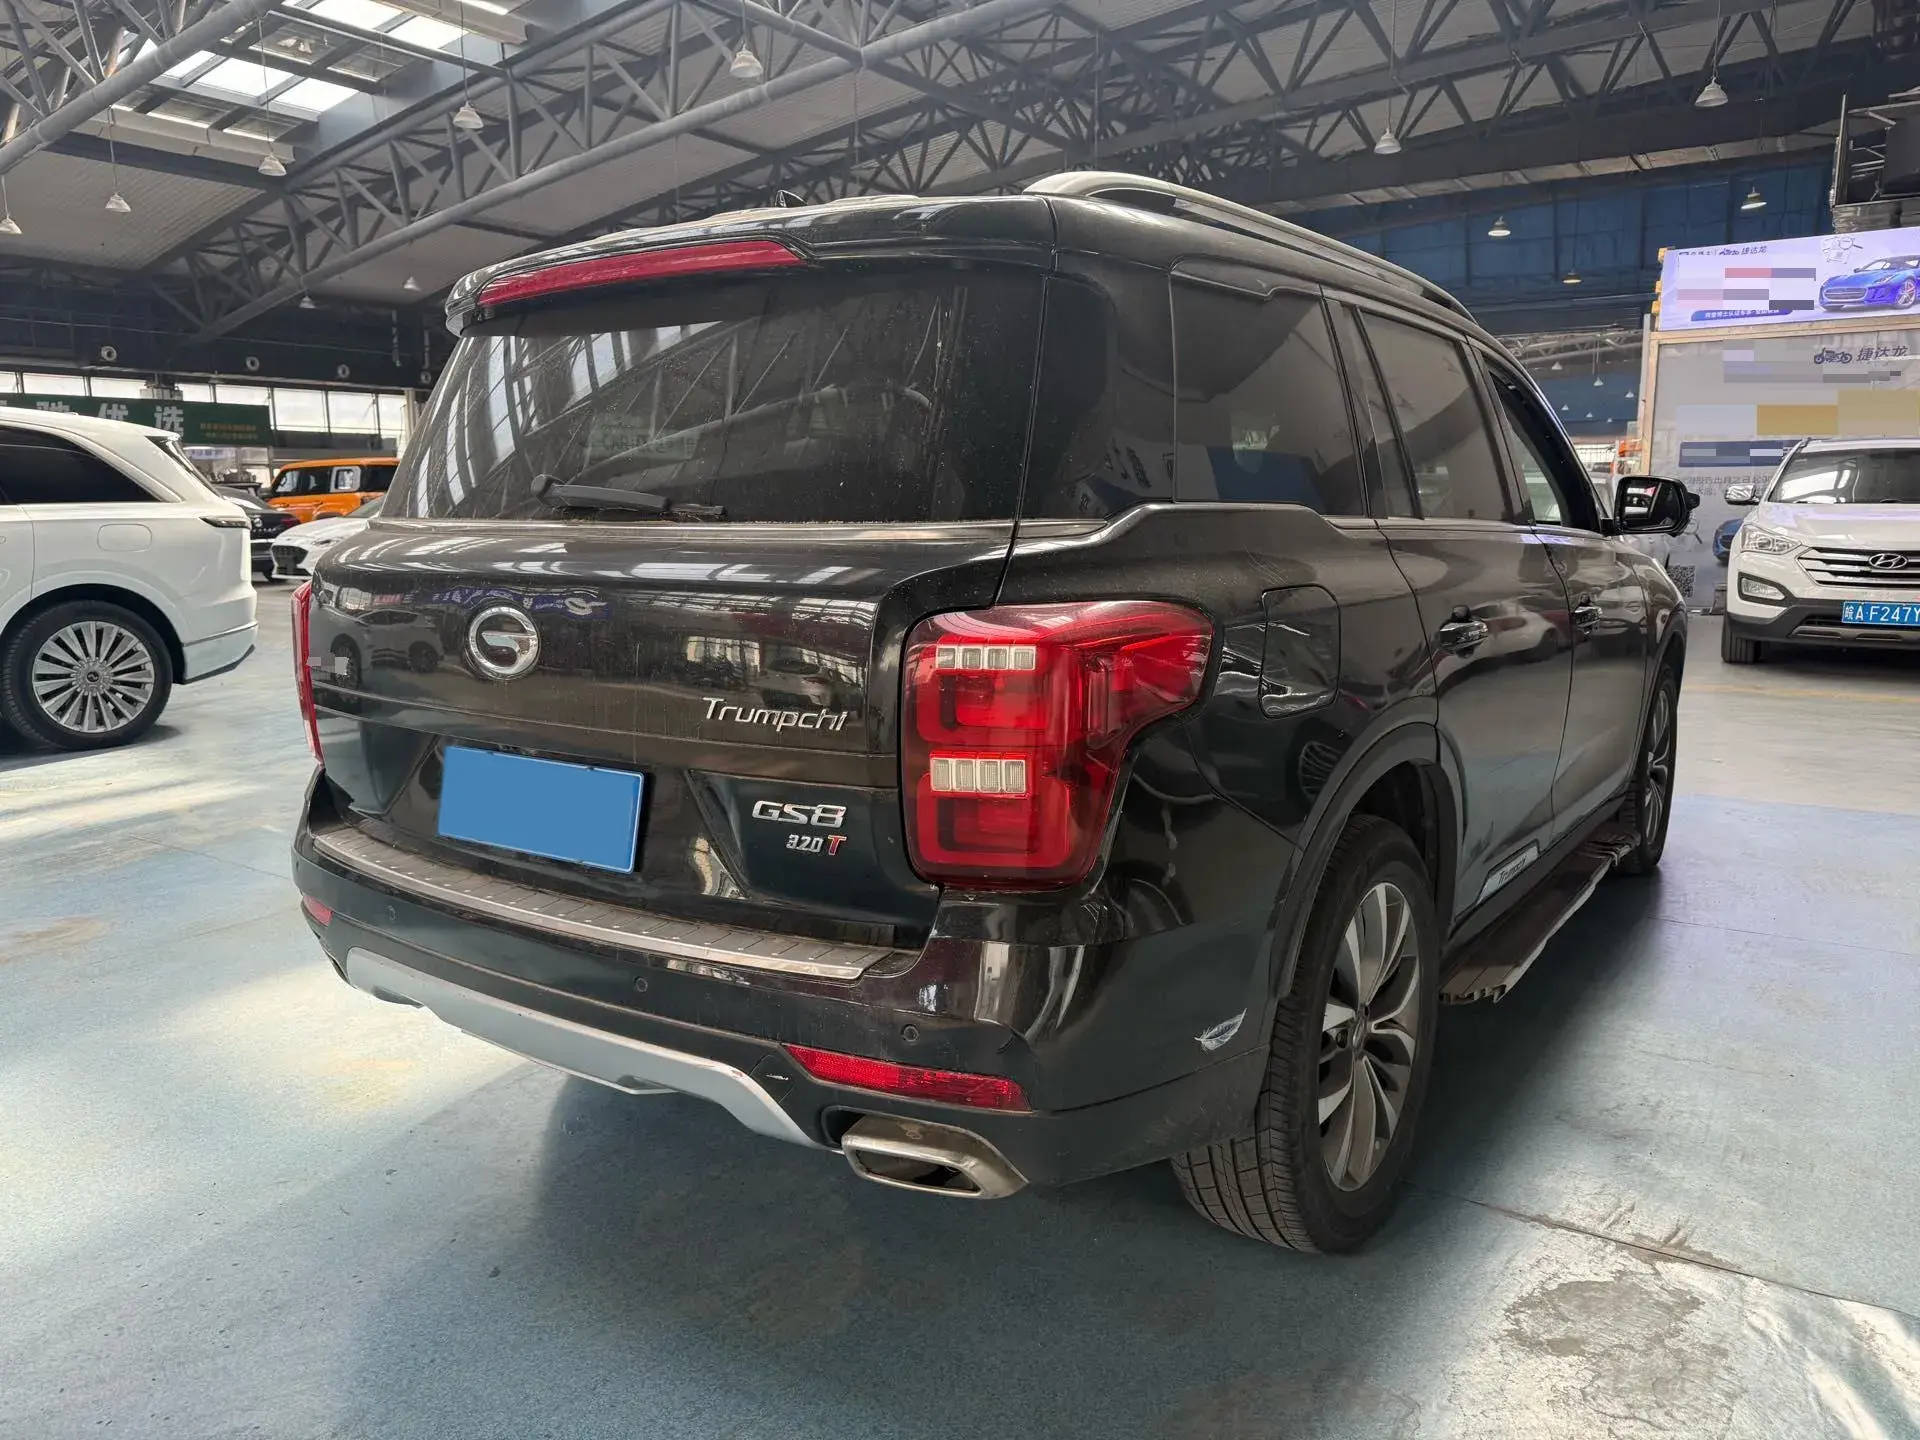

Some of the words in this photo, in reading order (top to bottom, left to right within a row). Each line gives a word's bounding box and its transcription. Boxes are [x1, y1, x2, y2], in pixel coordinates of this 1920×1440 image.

[1856, 346, 1908, 361] 捷达龙
[702, 697, 848, 732] Trumpchi
[752, 800, 847, 828] GS8
